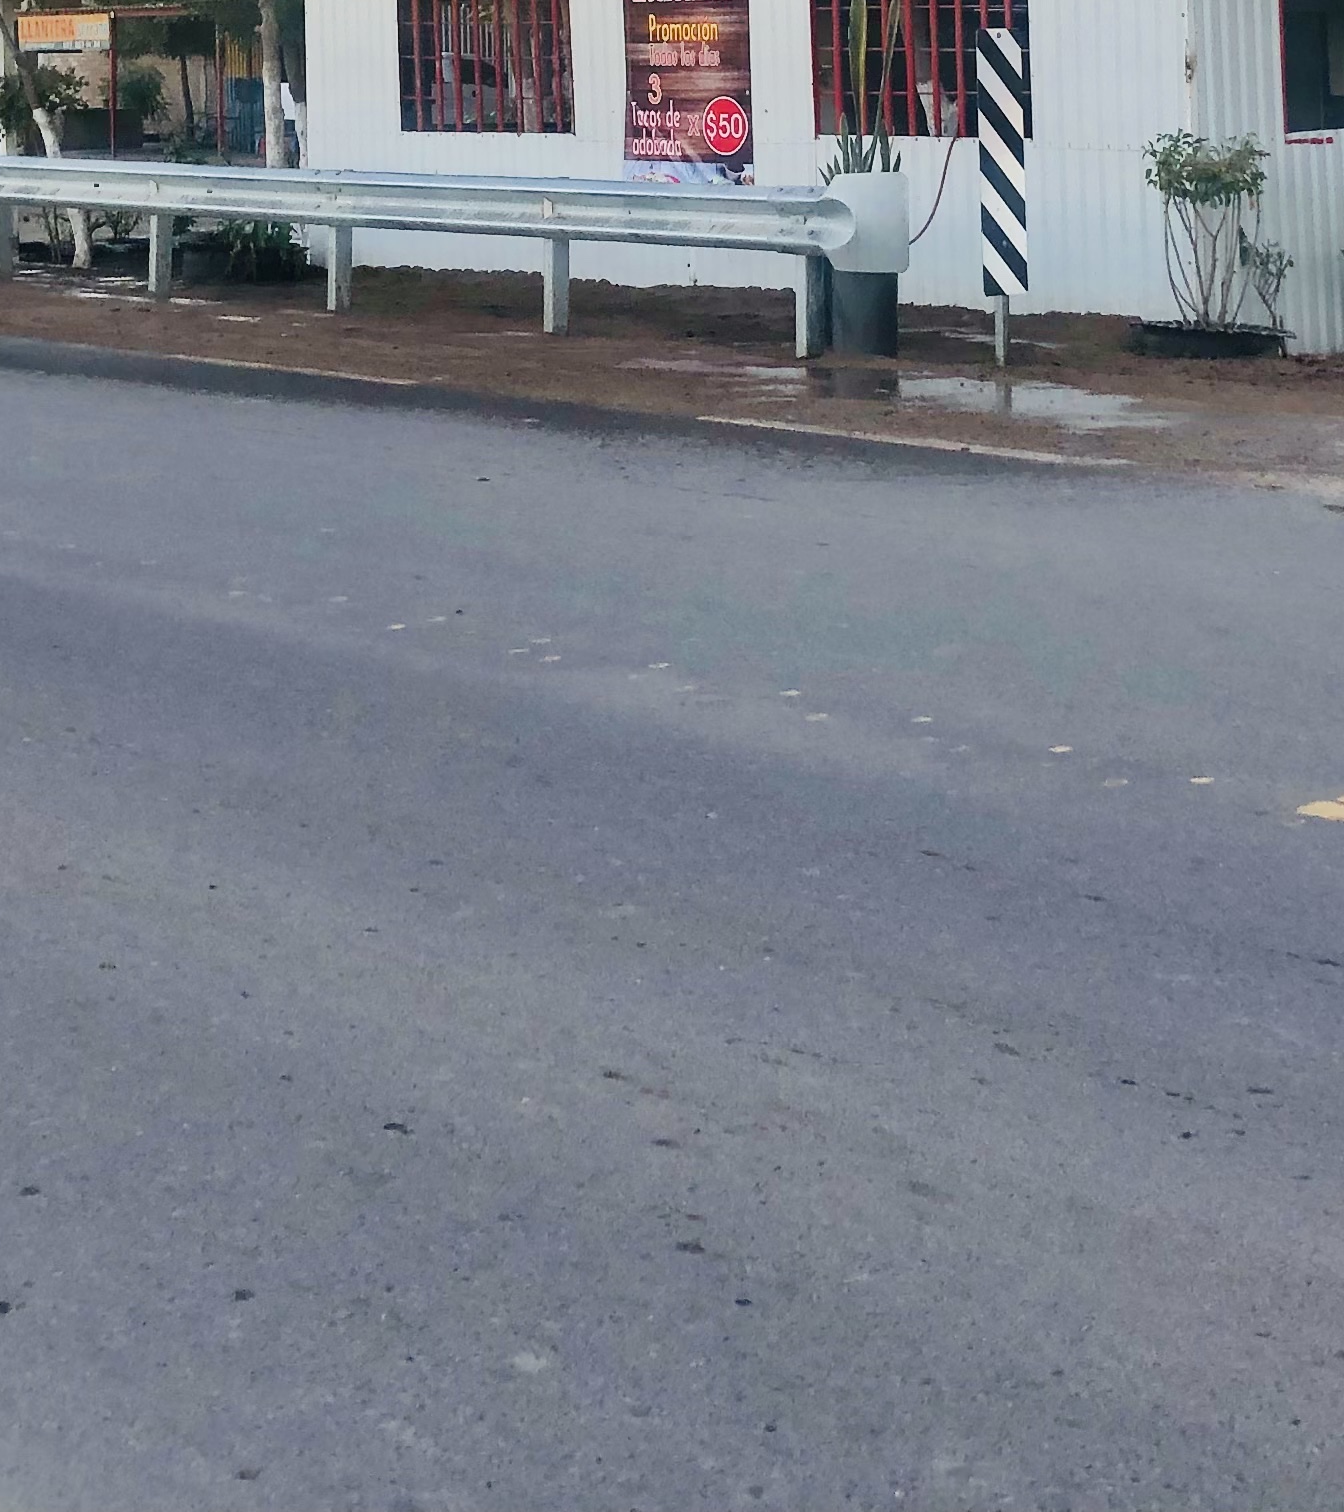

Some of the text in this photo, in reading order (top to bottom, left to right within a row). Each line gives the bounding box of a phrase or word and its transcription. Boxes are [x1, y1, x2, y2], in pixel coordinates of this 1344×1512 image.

[648, 13, 718, 42] Promoción
[648, 73, 662, 104] 3
[631, 99, 681, 128] Tacos de
[706, 110, 743, 141] $50
[632, 128, 682, 156] adobada
